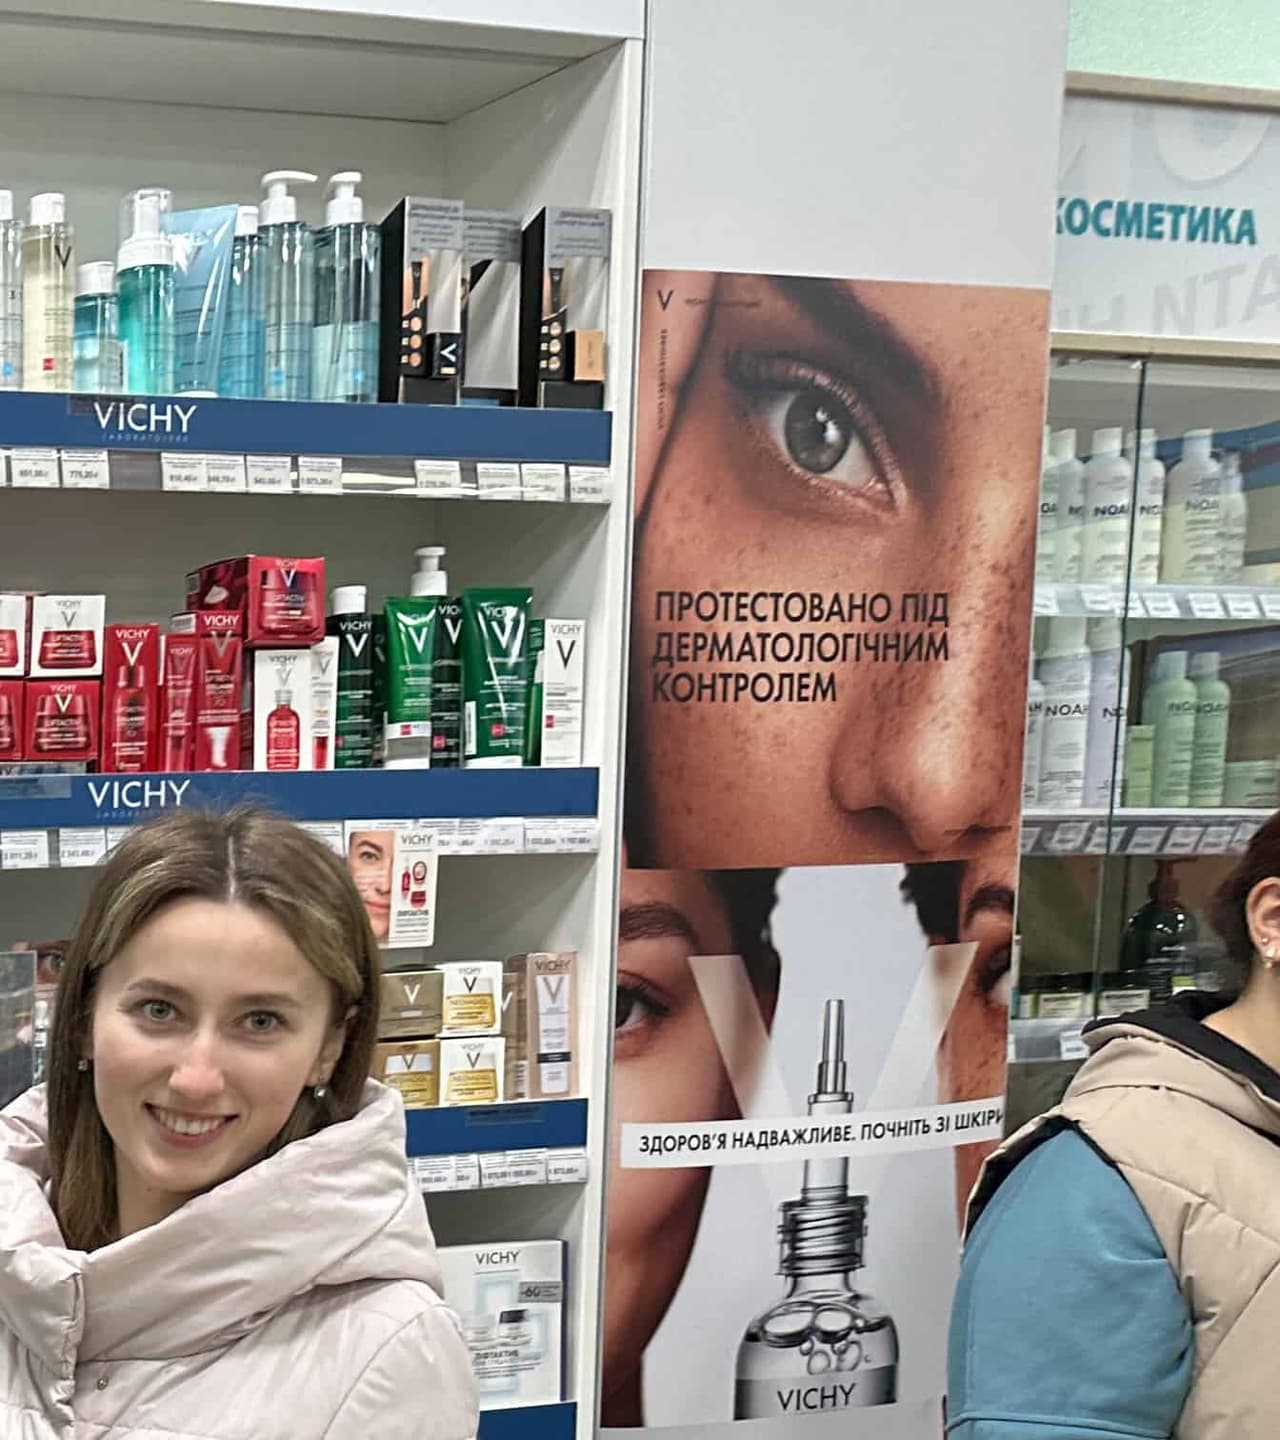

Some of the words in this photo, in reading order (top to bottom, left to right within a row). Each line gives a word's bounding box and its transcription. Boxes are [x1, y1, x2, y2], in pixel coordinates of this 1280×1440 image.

[94, 403, 196, 433] VICHY
[655, 591, 891, 622] ПРОТЕСТОВАНО
[899, 591, 949, 628] ПІД
[204, 614, 239, 627] VICHY
[339, 620, 372, 632] VICHY
[550, 624, 582, 635] VICHY
[116, 629, 150, 640] VICHY
[652, 632, 949, 668] ДЕРМАТОЛОГІЧНИМ
[652, 673, 837, 702] КОНТРОЛЕМ
[89, 780, 190, 808] VICHY
[401, 834, 432, 845] VICHY
[534, 959, 571, 971] VICHY
[732, 1125, 855, 1150] НАДВАЖЛИВЕ.
[861, 1118, 930, 1143] ПОЧНІТЬ
[935, 1116, 951, 1135] ЗІ
[475, 1251, 521, 1265] VICHY
[777, 1383, 856, 1412] VICHY
